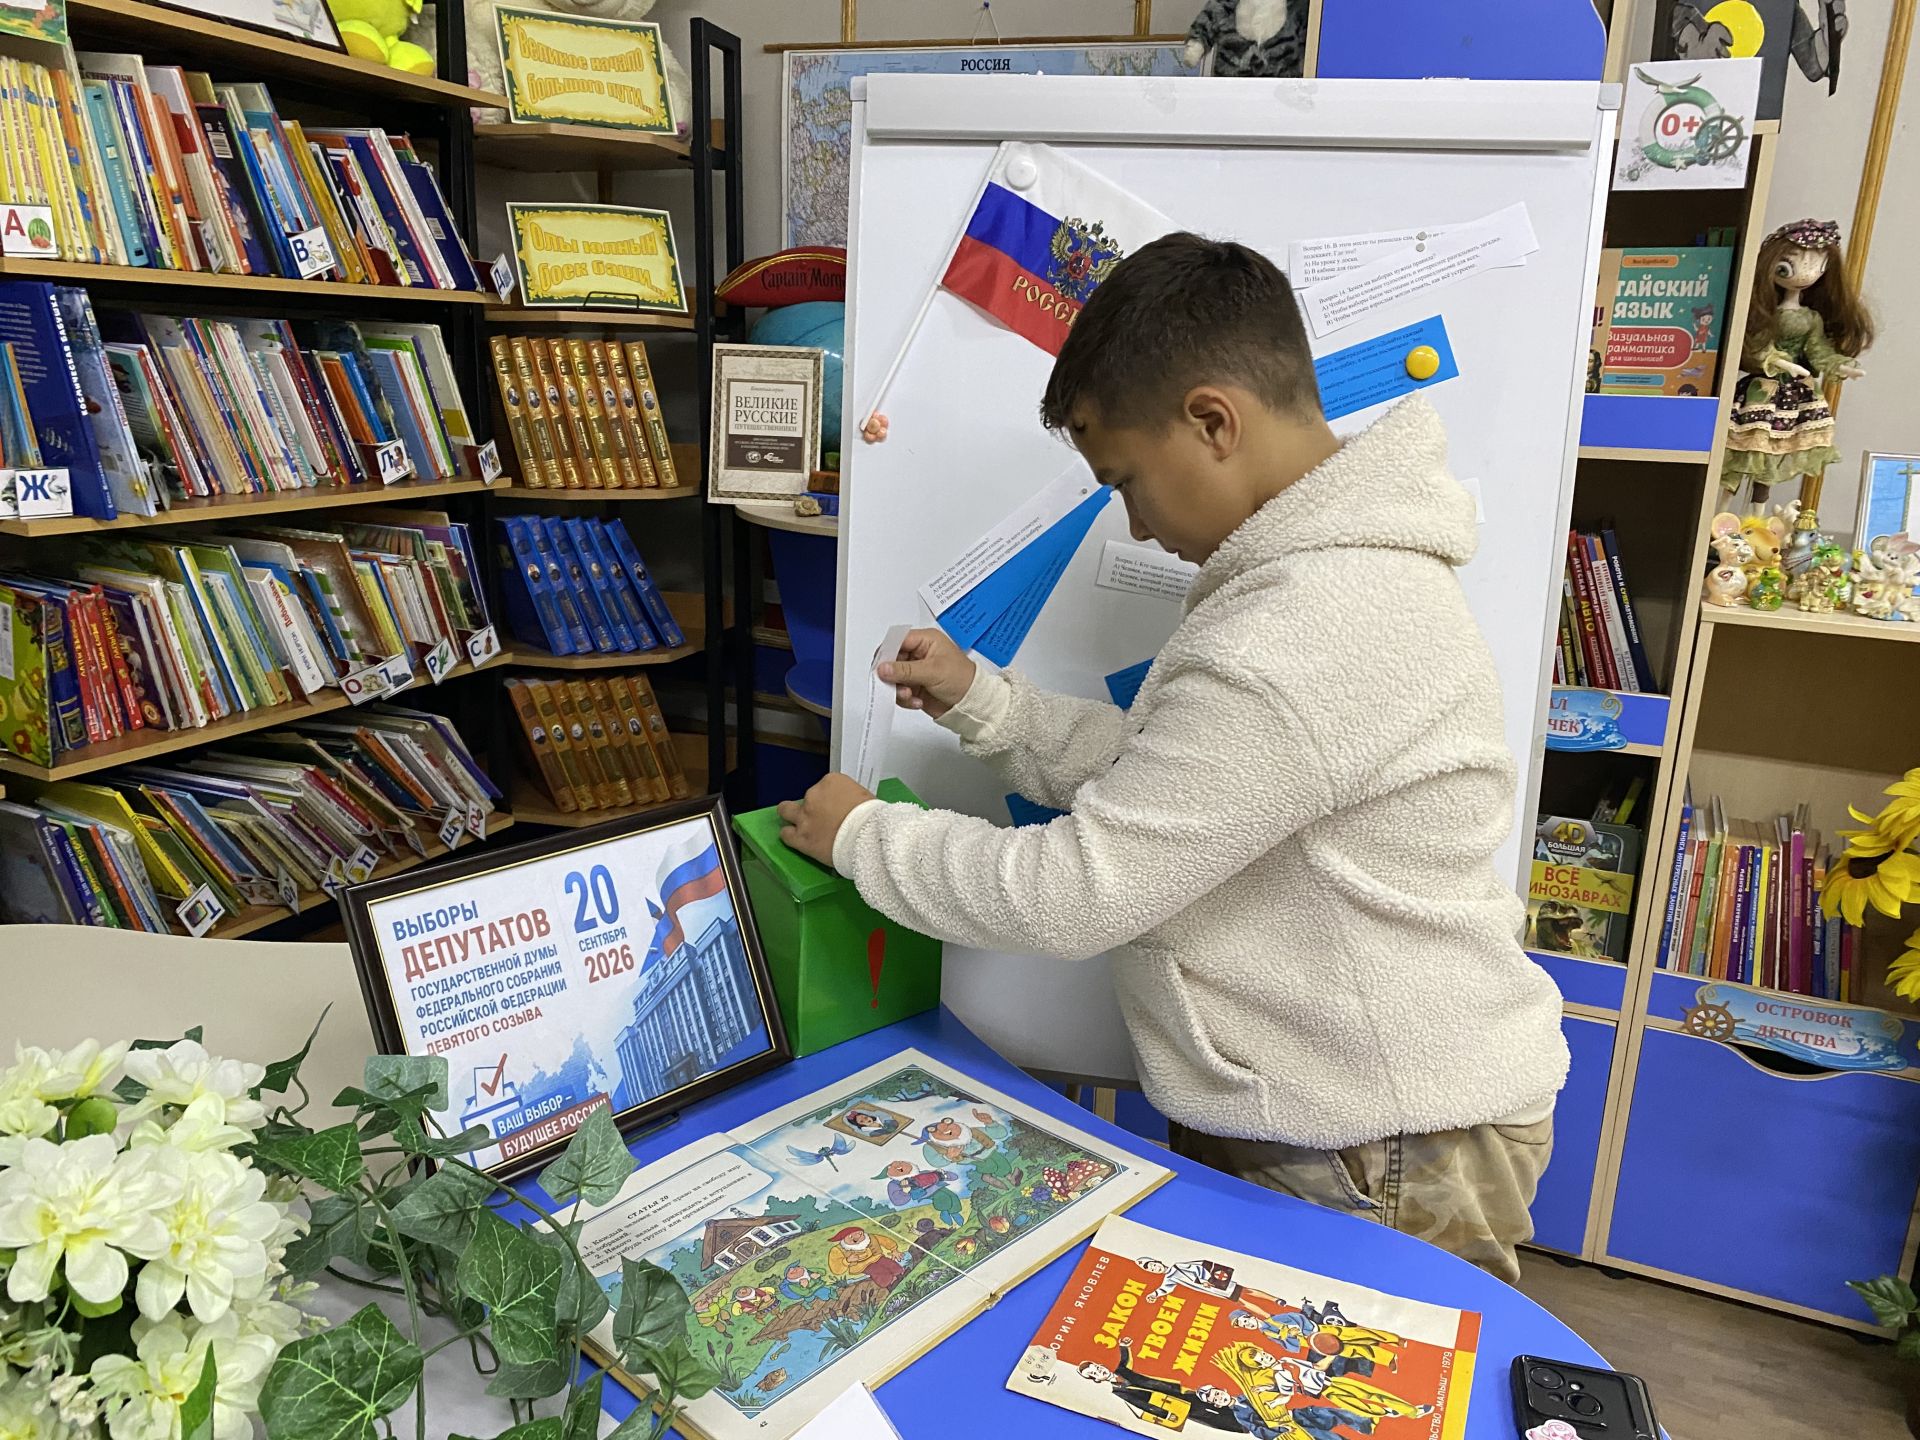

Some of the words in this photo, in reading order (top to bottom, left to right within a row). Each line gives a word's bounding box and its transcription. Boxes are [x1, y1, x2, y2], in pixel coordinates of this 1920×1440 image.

[517, 24, 588, 70] Великое
[590, 48, 644, 72] начало
[961, 58, 1011, 72] РОССИЯ
[527, 73, 604, 104] большого
[1661, 115, 1700, 138] 0+
[5, 208, 26, 236] А
[292, 238, 309, 262] В
[530, 222, 579, 253] Олы
[761, 266, 807, 290] Captain
[1617, 273, 1710, 298] ТАЙСКИЙ
[48, 293, 68, 343] БАБУШКА
[1613, 301, 1674, 320] ЯЗЫК
[1606, 344, 1675, 355] рамматика
[62, 344, 88, 416] КОСМИЧЕСКАЯ
[735, 395, 798, 411] ВЕЛИКИЕ
[735, 409, 798, 425] РУССКИЕ
[382, 450, 395, 473] Л
[480, 449, 492, 473] М
[21, 475, 50, 502] Ж
[1572, 556, 1587, 596] ДЕТСКАЯ
[1610, 554, 1623, 581] РОБОТЫ
[263, 578, 295, 627] Добывайки
[1579, 599, 1595, 632] АВТО
[470, 640, 482, 657] С
[427, 655, 438, 675] Р
[1553, 821, 1586, 846] 4D
[1676, 830, 1688, 851] КНИГА
[1547, 841, 1586, 854] БОЛЬШАЯ
[1544, 866, 1580, 886] ВСЁ
[1668, 852, 1685, 893] ИНТЕРЕСНЫХ
[564, 864, 620, 933] 20
[1529, 881, 1622, 908] ИНОЗАВРАХ
[1731, 902, 1743, 942] ВЫПИЛИВАЕМ
[1737, 868, 1745, 893] ФАНЕРЫ
[392, 899, 479, 941] ВЫБОРЫ
[401, 908, 551, 983] ДЕПУТАТОВ
[578, 926, 628, 952] СЕНТЯБРЯ
[411, 951, 522, 1001] ГОСУДАРСТВЕННОЙ
[524, 944, 558, 968] ДУМЫ
[584, 944, 635, 984] 2026
[416, 978, 504, 1019] ФЕДЕРАЛЬНОГО
[506, 960, 563, 992] СОБРАНИЯ
[420, 1000, 499, 1039] РОССИЙСКОЙ
[501, 978, 568, 1011] ФЕДЕРАЦИИ
[1755, 1001, 1854, 1029] ОСТРОВОК
[426, 1024, 490, 1057] ДЕВЯТОГО
[493, 1006, 543, 1033] СОЗЫВА
[1755, 1024, 1837, 1049] ДЕТСТВА
[497, 1113, 524, 1136] ВАШ
[525, 1098, 563, 1126] ВЫБОР
[503, 1121, 560, 1158] БУДУЩЕЕ
[560, 1097, 607, 1131] РОССИ
[626, 1199, 659, 1220] СТАТЬЯ
[658, 1194, 669, 1202] 20
[592, 1226, 623, 1247] Каждый
[641, 1225, 667, 1243] группу
[667, 1217, 681, 1228] или
[1074, 1255, 1110, 1309] ЯКОВЛЕВ
[1093, 1278, 1148, 1349] ЗАКОН
[1136, 1294, 1186, 1360] ТВОЕЙ
[1172, 1302, 1221, 1377] ЖИЗНИ
[1441, 1351, 1453, 1369] 1979
